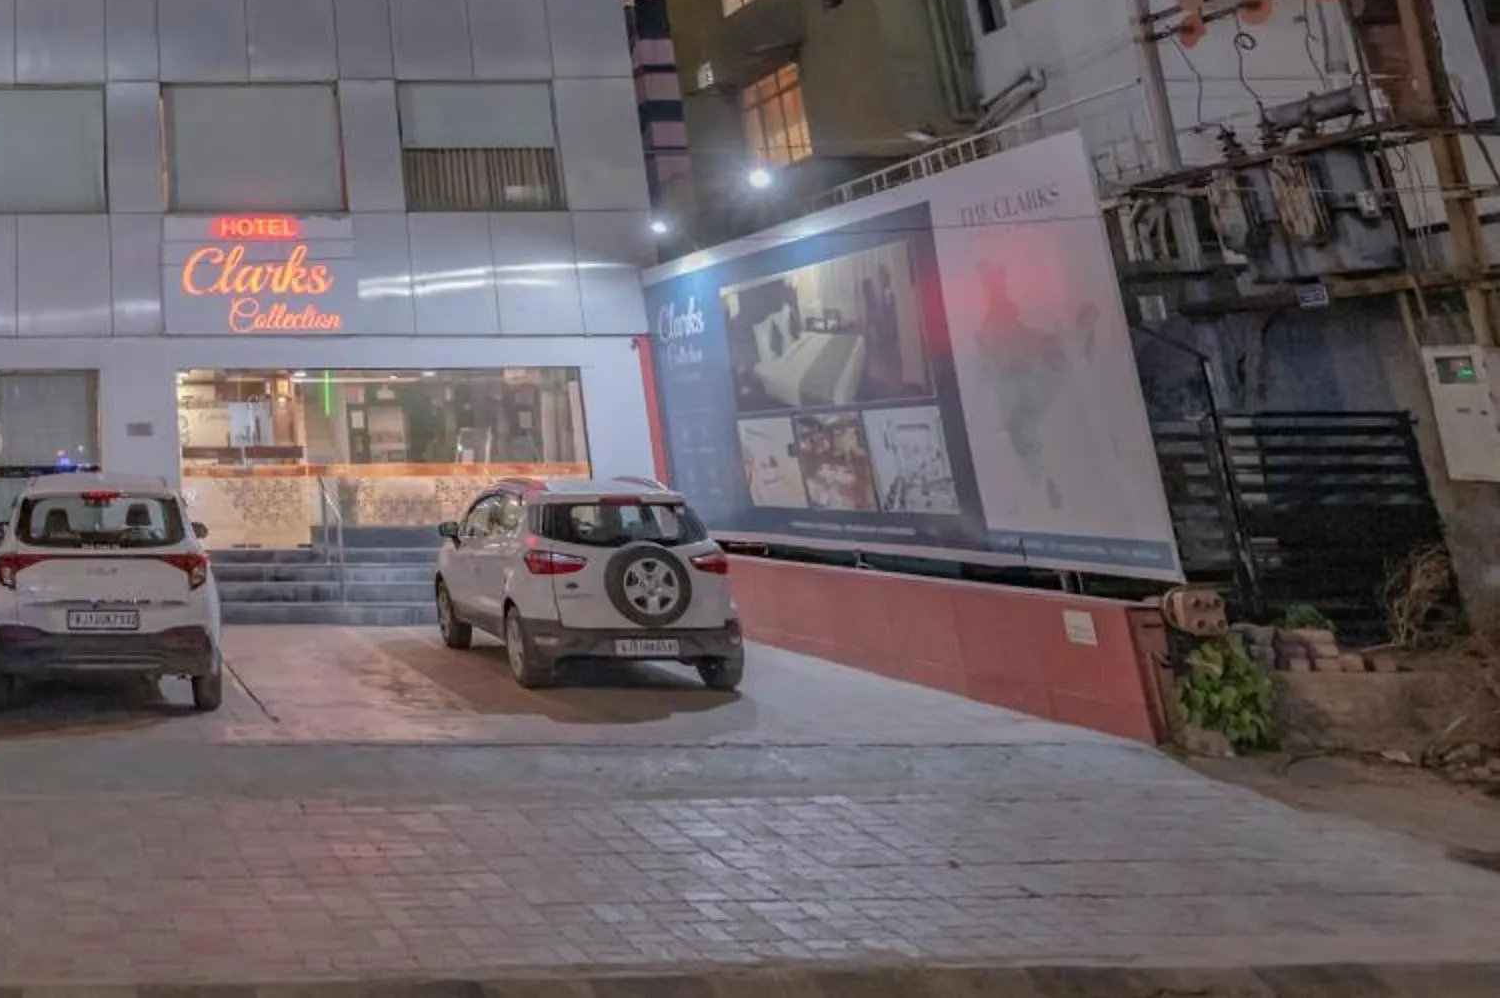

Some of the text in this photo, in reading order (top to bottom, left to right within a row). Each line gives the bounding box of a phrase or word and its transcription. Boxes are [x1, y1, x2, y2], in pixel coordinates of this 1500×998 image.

[993, 184, 1060, 220] CLARKS
[220, 217, 296, 236] HOTEL
[182, 245, 333, 295] Clarks
[229, 297, 343, 333] Collection
[658, 295, 705, 343] Clarks
